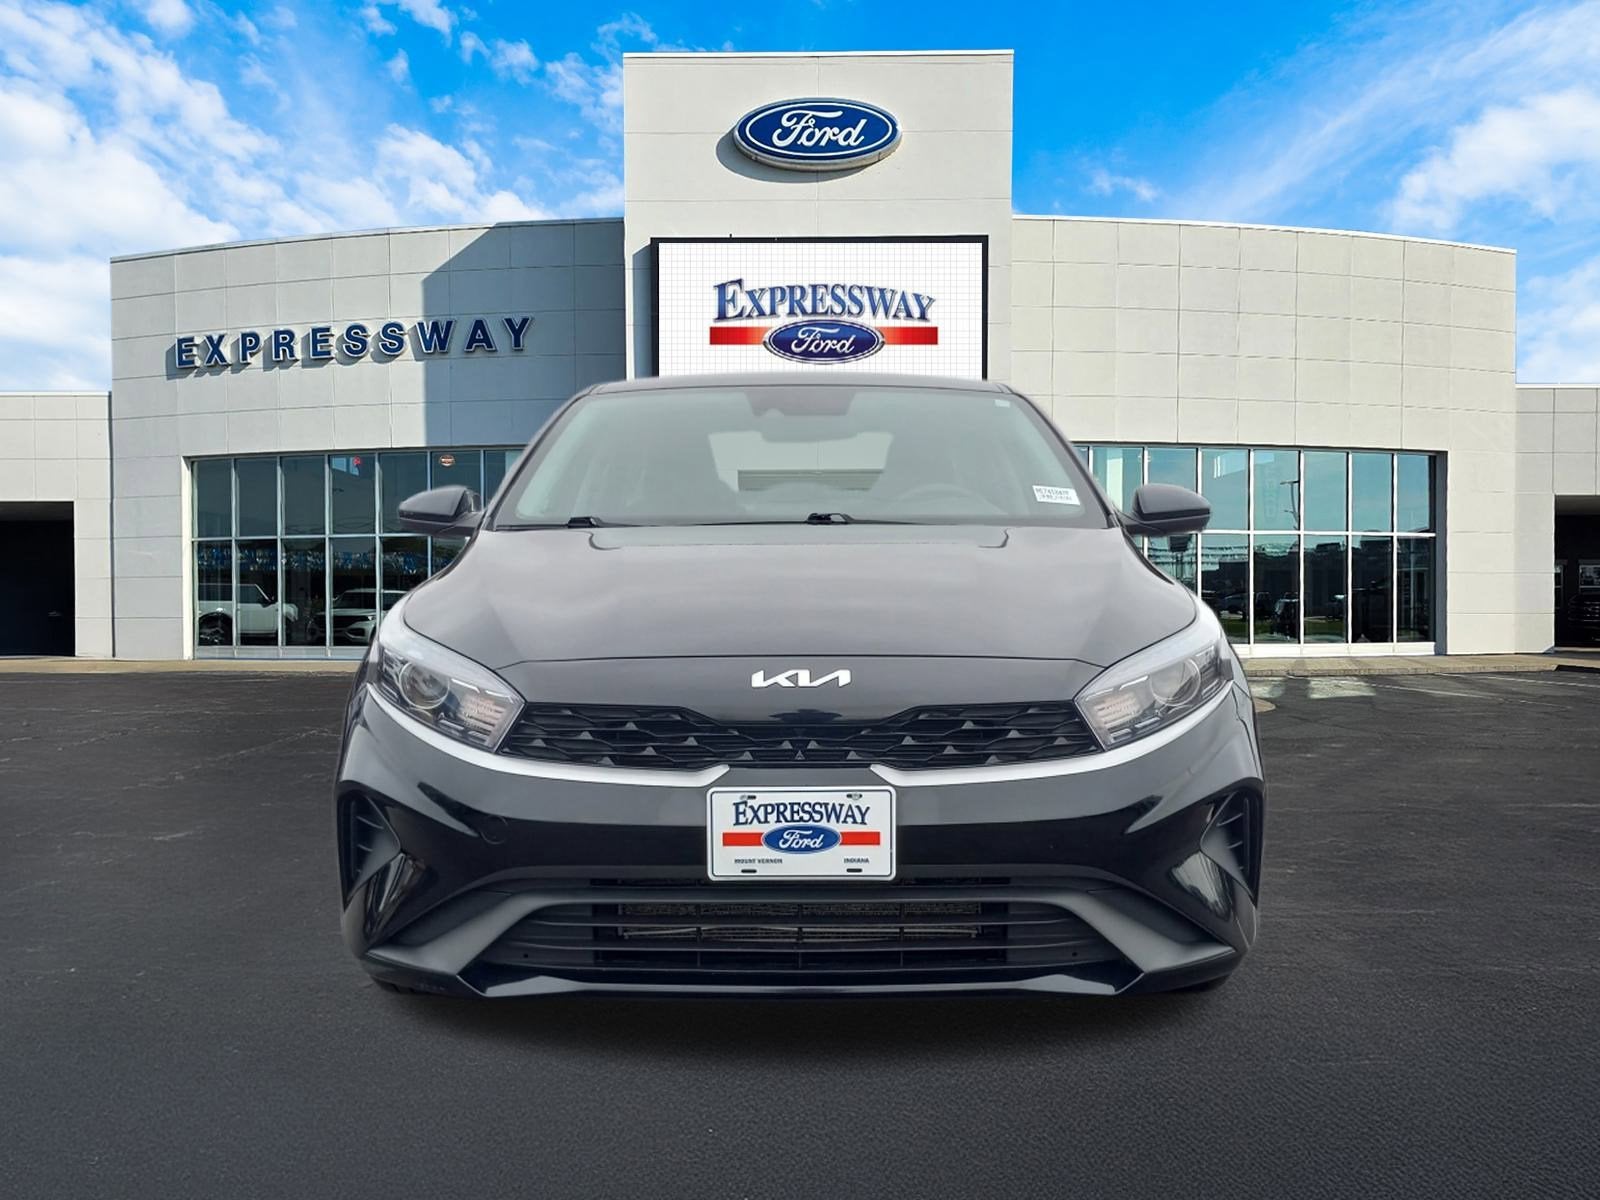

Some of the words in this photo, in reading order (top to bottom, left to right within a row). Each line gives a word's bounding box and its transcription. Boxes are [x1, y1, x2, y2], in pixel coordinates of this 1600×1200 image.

[772, 110, 867, 146] Ford
[713, 278, 935, 322] EXPRESSWAY
[175, 316, 533, 368] EXPRESSWAY
[791, 326, 855, 353] Ford
[752, 669, 851, 688] KIA
[733, 801, 870, 826] EXPRESSWAY
[779, 829, 823, 848] Ford
